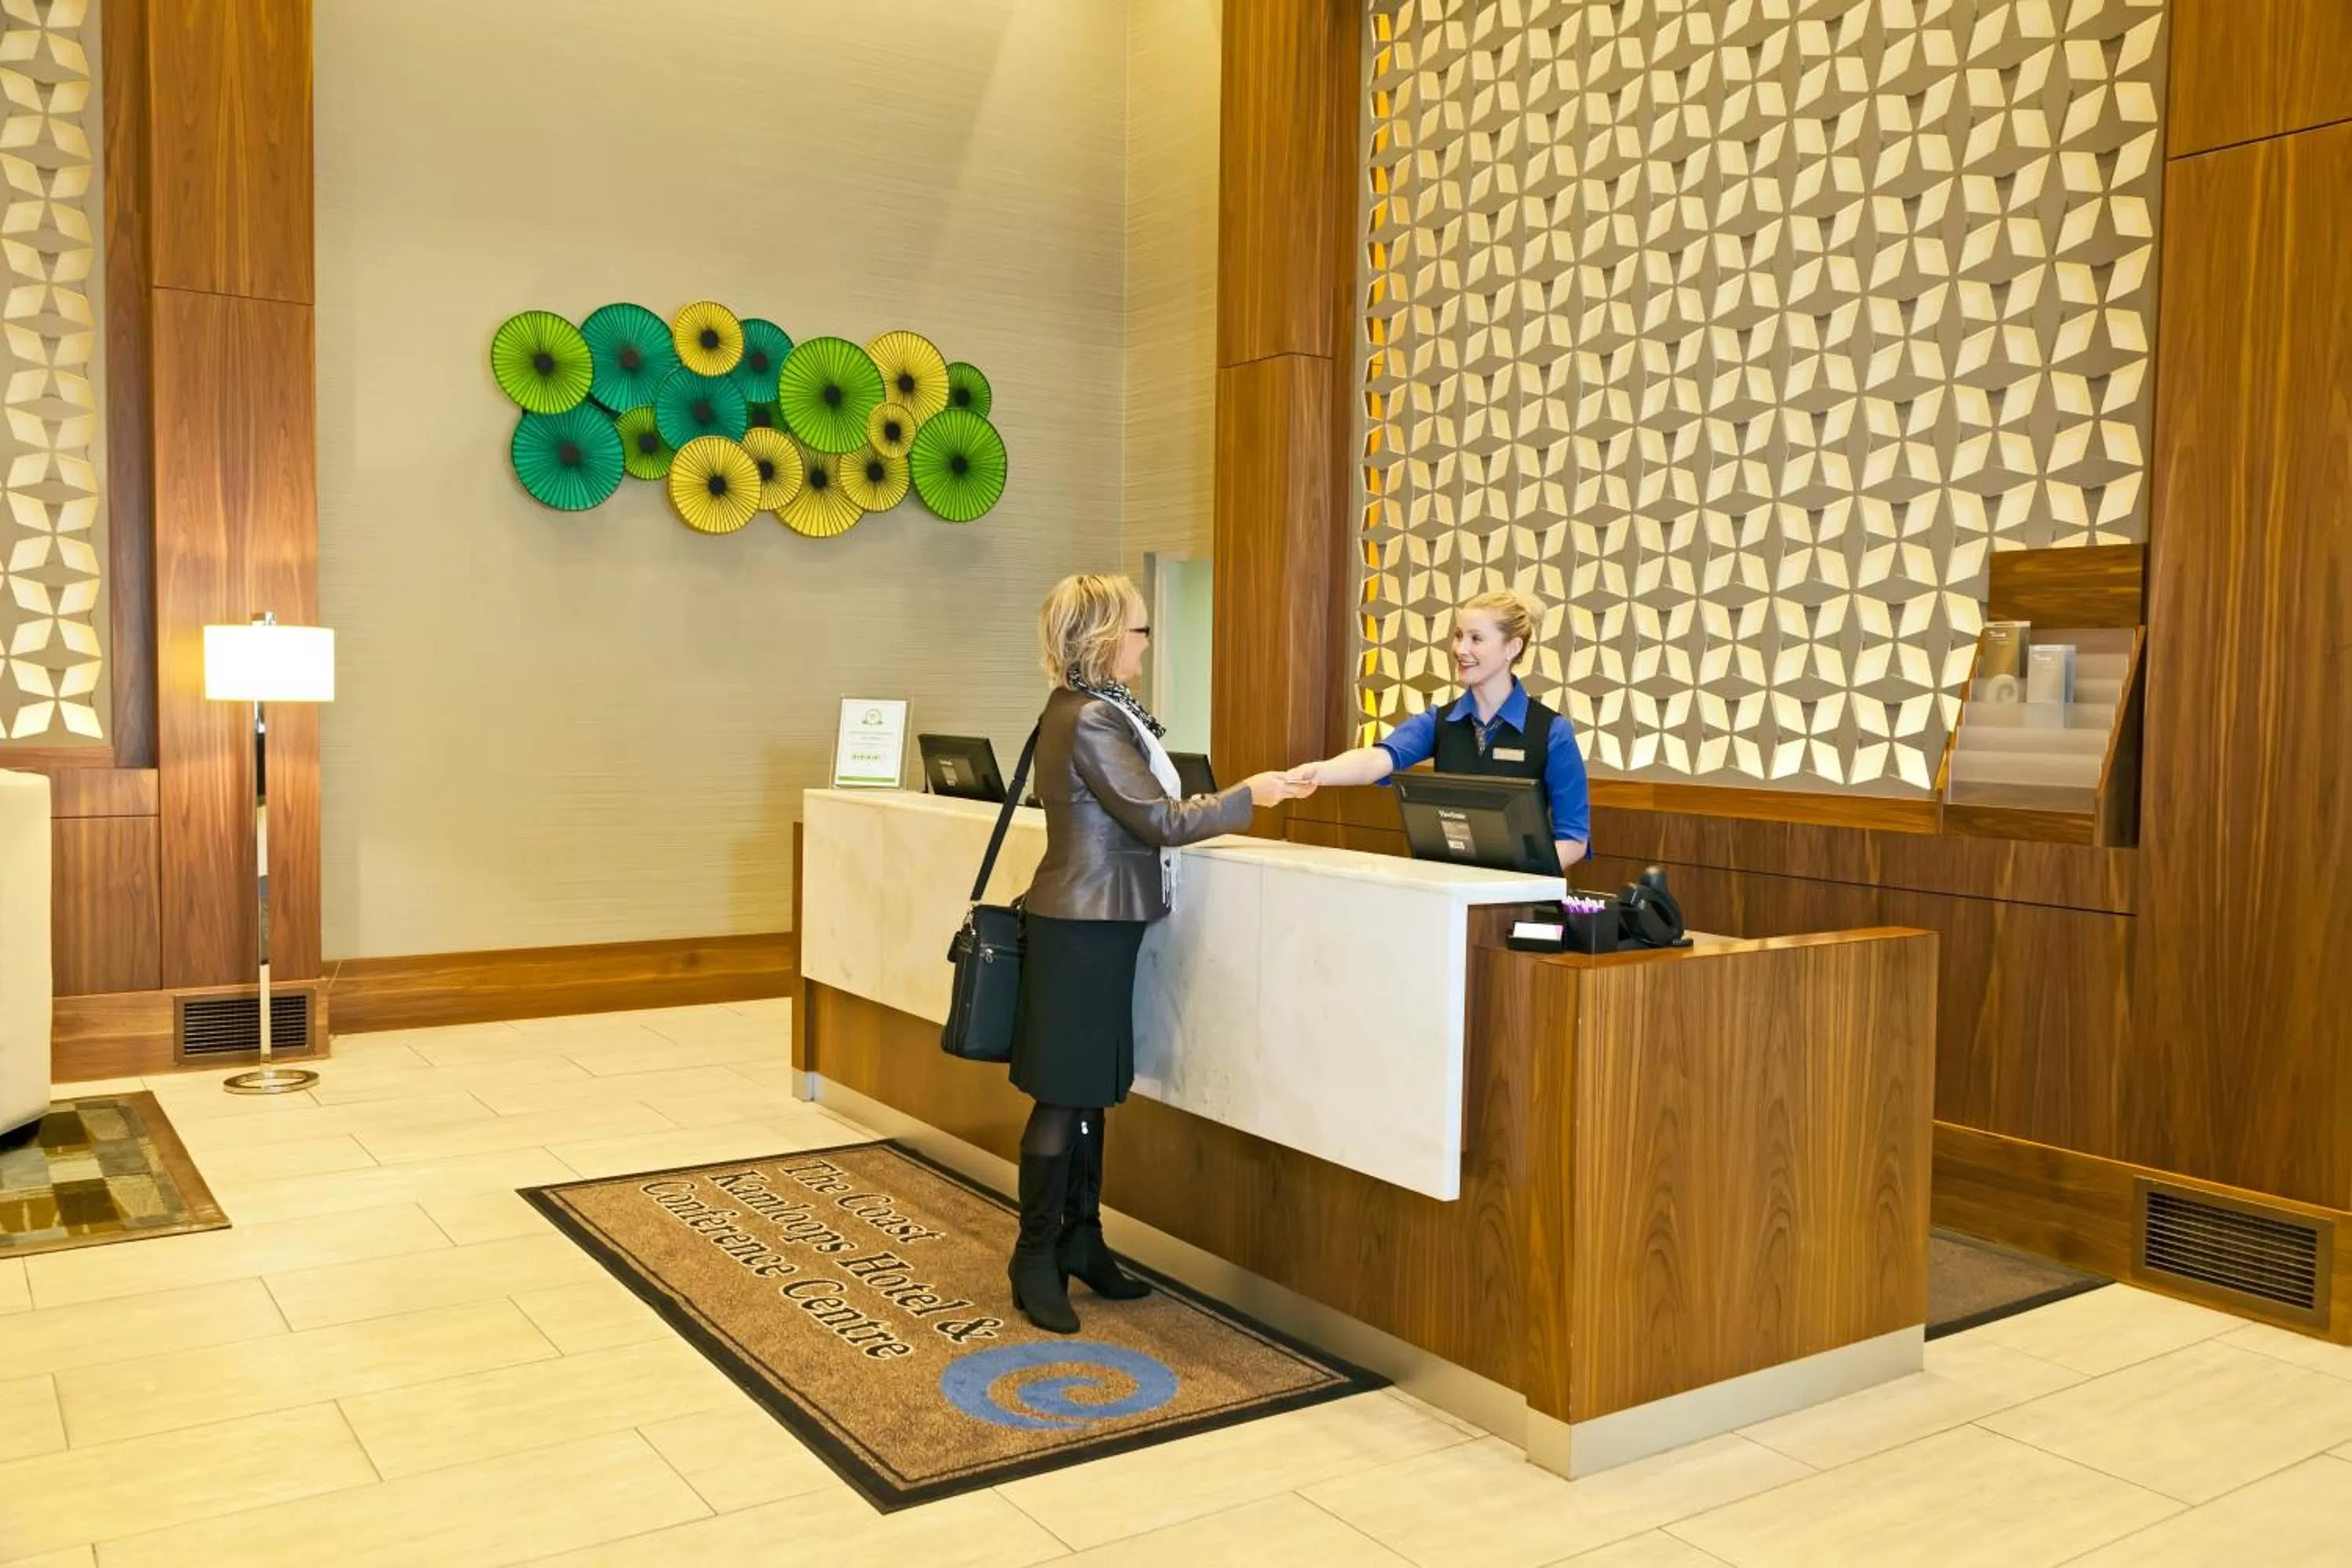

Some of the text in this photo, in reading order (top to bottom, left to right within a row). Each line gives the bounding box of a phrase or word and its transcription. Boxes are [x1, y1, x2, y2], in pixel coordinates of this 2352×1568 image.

[641, 1181, 913, 1359] Conference Centre
[706, 1170, 1003, 1342] Kamloops Hotel &
[779, 1160, 946, 1243] The Coast
